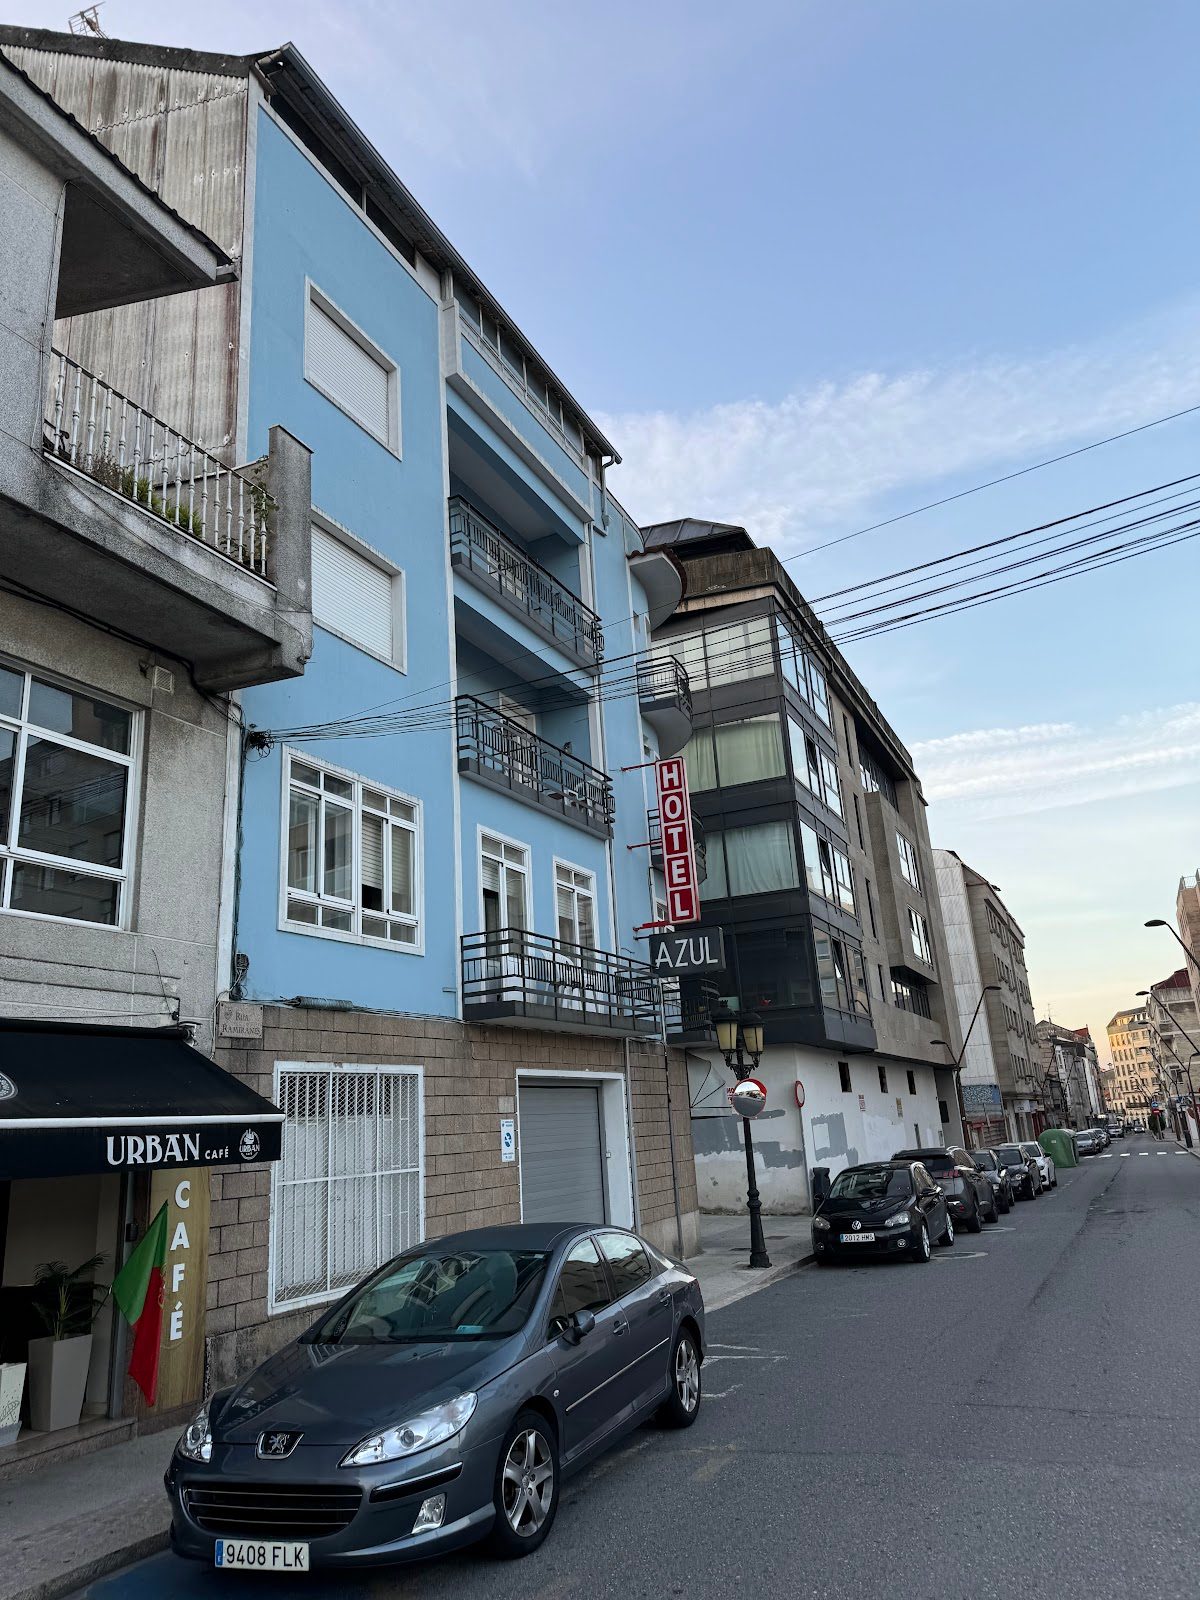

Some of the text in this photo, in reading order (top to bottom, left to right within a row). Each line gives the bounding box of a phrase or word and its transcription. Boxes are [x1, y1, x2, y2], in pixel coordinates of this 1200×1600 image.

[661, 763, 690, 918] HOTEL
[655, 936, 719, 968] AZUL
[106, 1133, 229, 1165] URBAN CAFÉ
[239, 1144, 260, 1153] URBAN
[169, 1180, 191, 1341] CAFÉ
[226, 1544, 266, 1566] 9408
[272, 1546, 304, 1567] FLK
